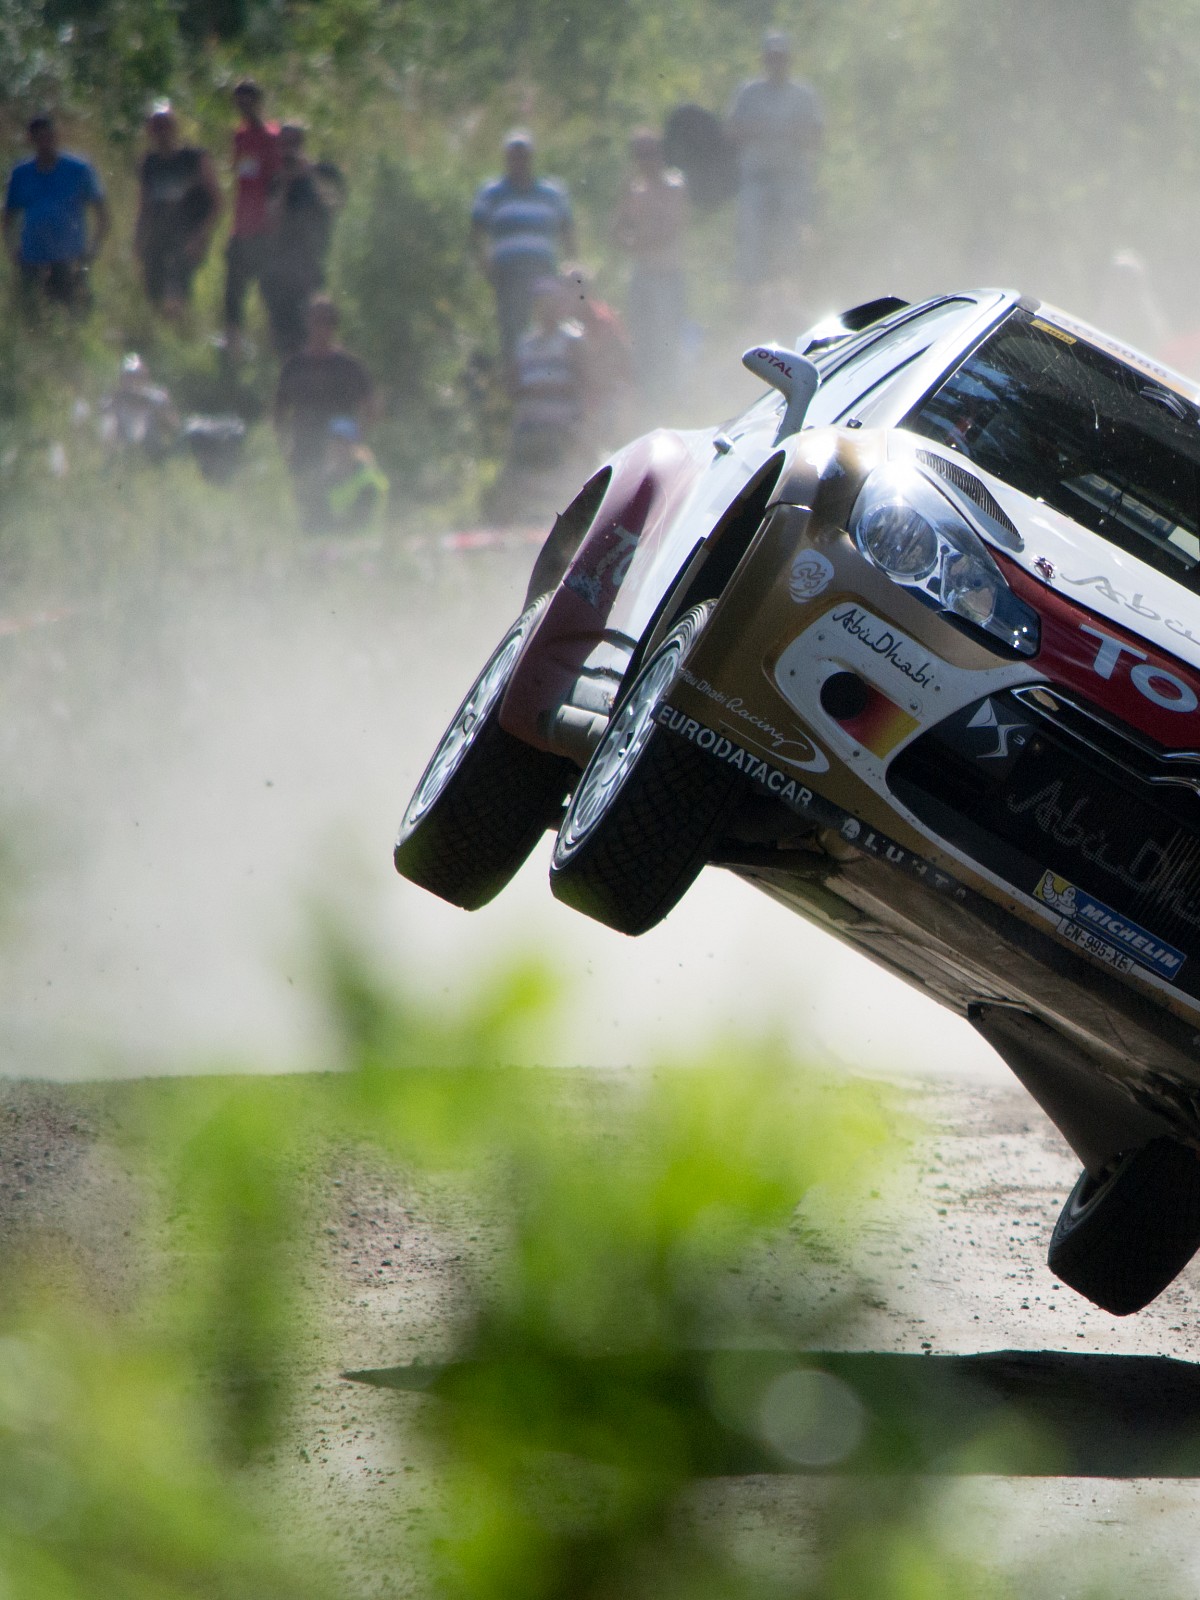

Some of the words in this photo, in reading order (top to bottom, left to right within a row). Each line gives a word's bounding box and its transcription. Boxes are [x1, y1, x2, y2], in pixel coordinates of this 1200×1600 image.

[725, 697, 809, 750] Racing
[657, 705, 813, 807] EURODATACAR
[1063, 922, 1130, 971] CN-995-XE
[1079, 903, 1181, 969] MICHELIN
